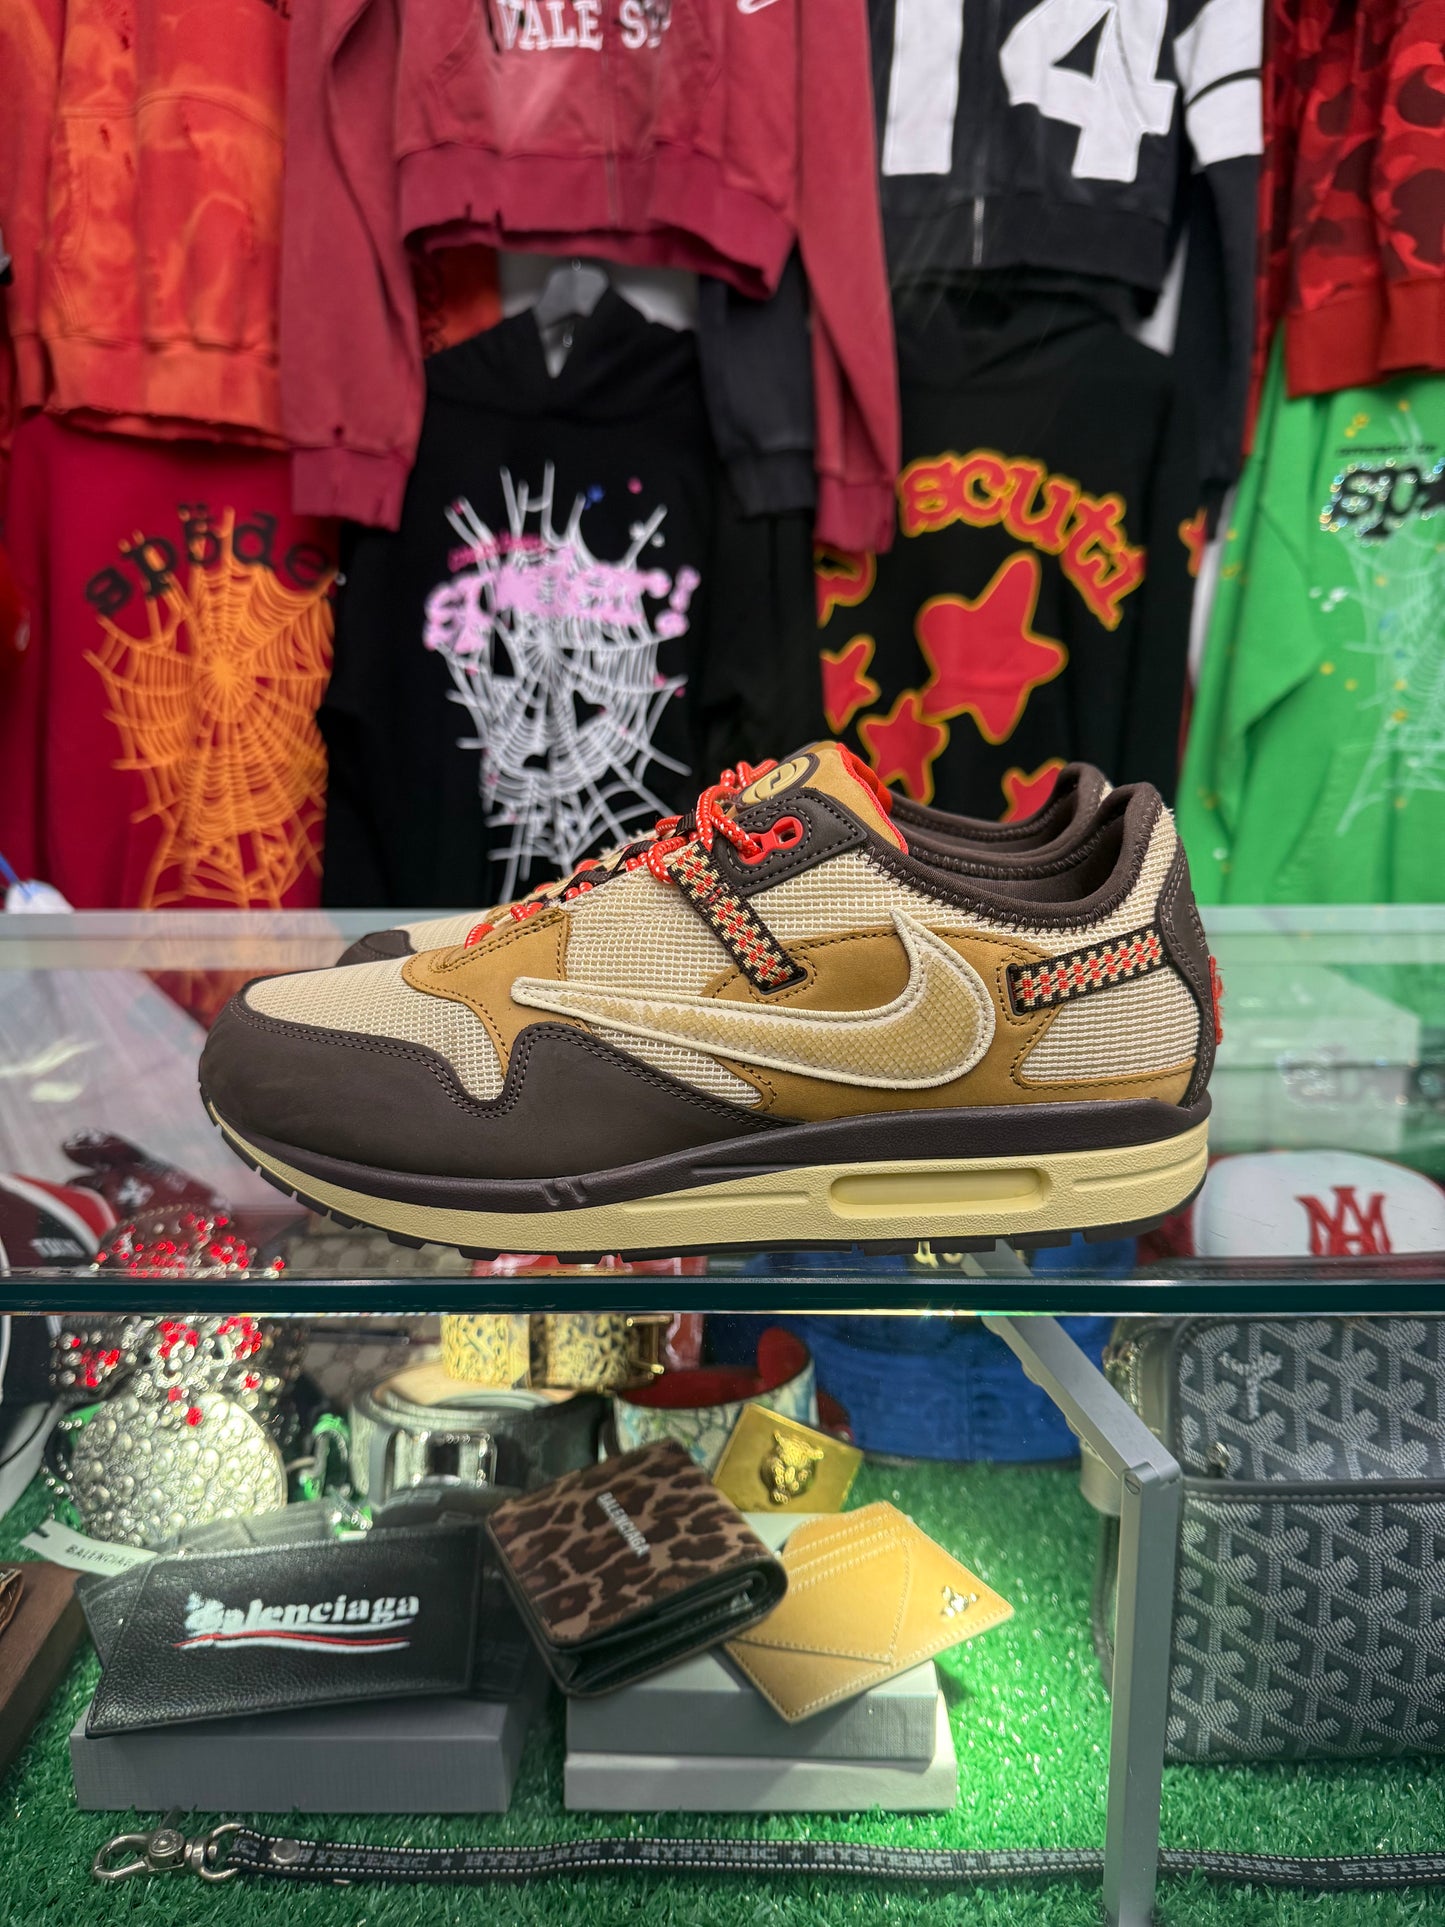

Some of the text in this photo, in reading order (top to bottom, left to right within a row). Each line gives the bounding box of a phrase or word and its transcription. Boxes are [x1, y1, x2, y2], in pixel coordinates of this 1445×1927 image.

[496, 0, 603, 51] VALE
[881, 0, 1178, 183] 14
[597, 1491, 651, 1558] BALENCIAGA
[638, 1844, 778, 1861] HYSTERIC
